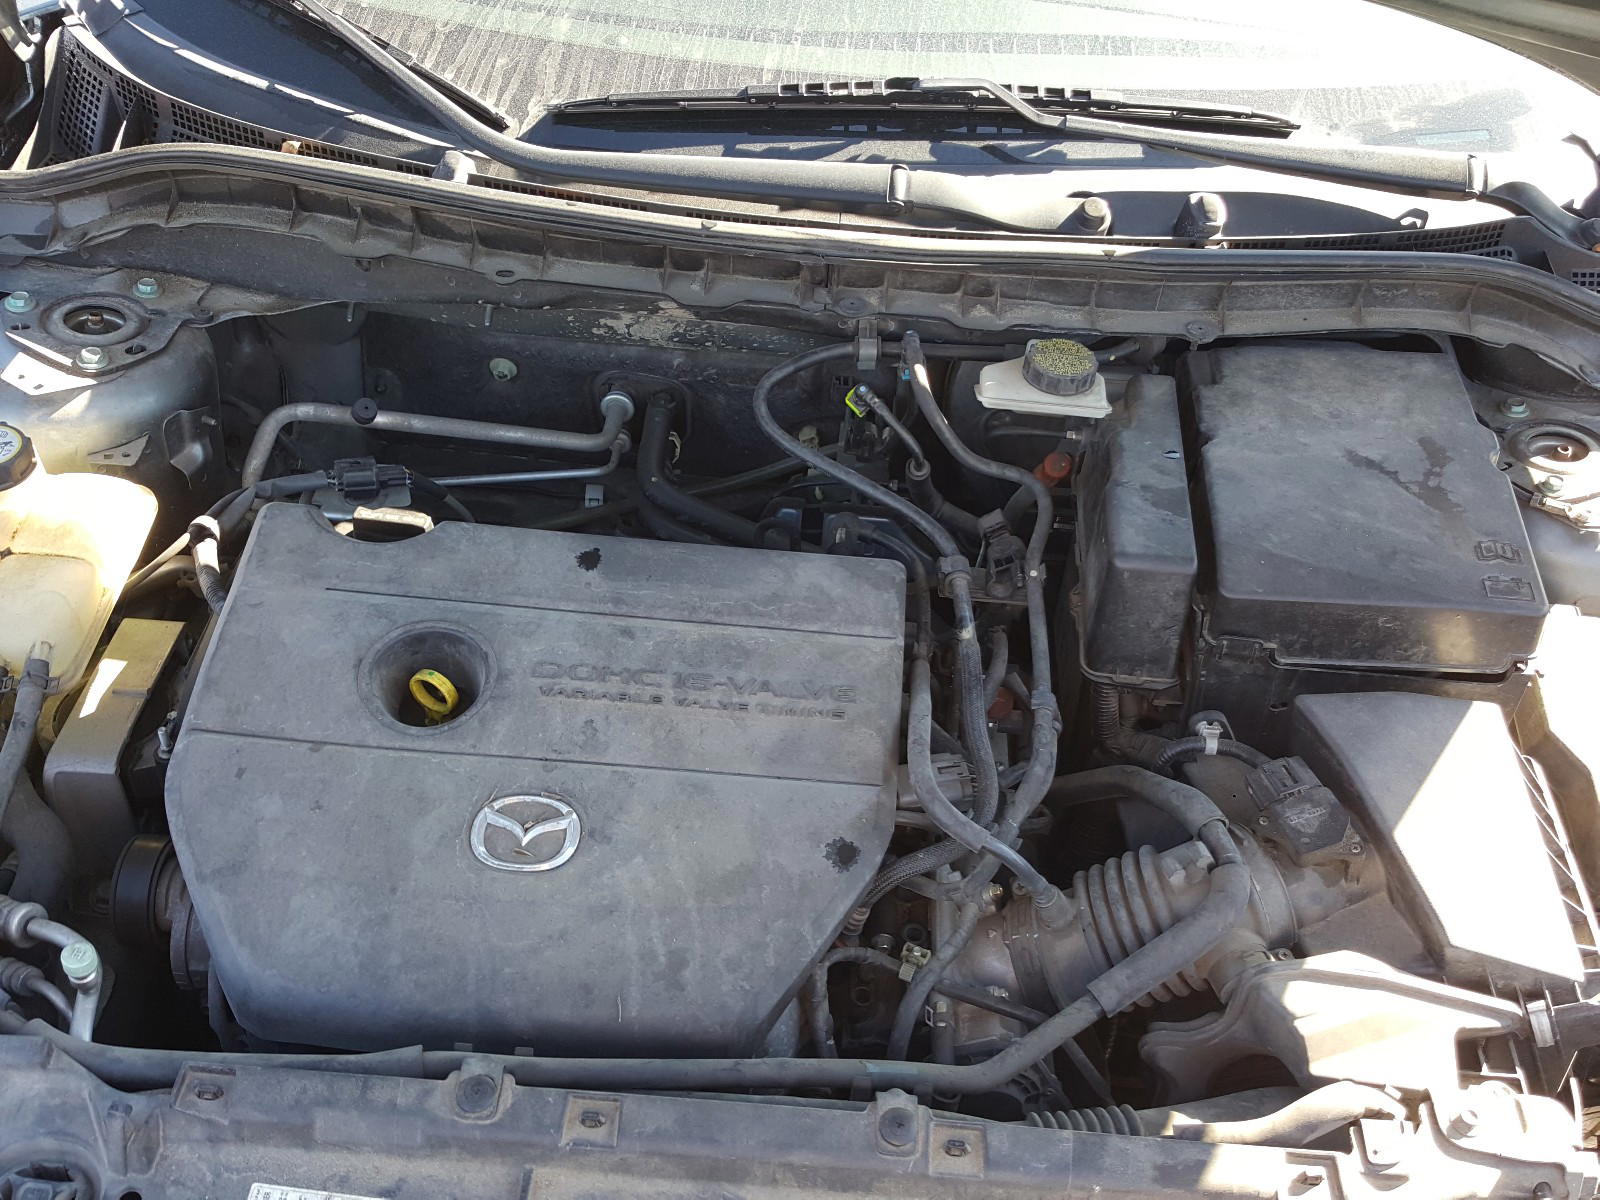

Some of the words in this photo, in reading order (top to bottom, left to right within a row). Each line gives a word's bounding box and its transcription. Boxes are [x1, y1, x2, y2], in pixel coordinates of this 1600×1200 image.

[531, 661, 667, 688] DOHC
[672, 671, 857, 704] 16-VALVE
[538, 685, 666, 705] VARIABLE
[672, 695, 750, 712] VALVE
[755, 703, 847, 721] TIMING
